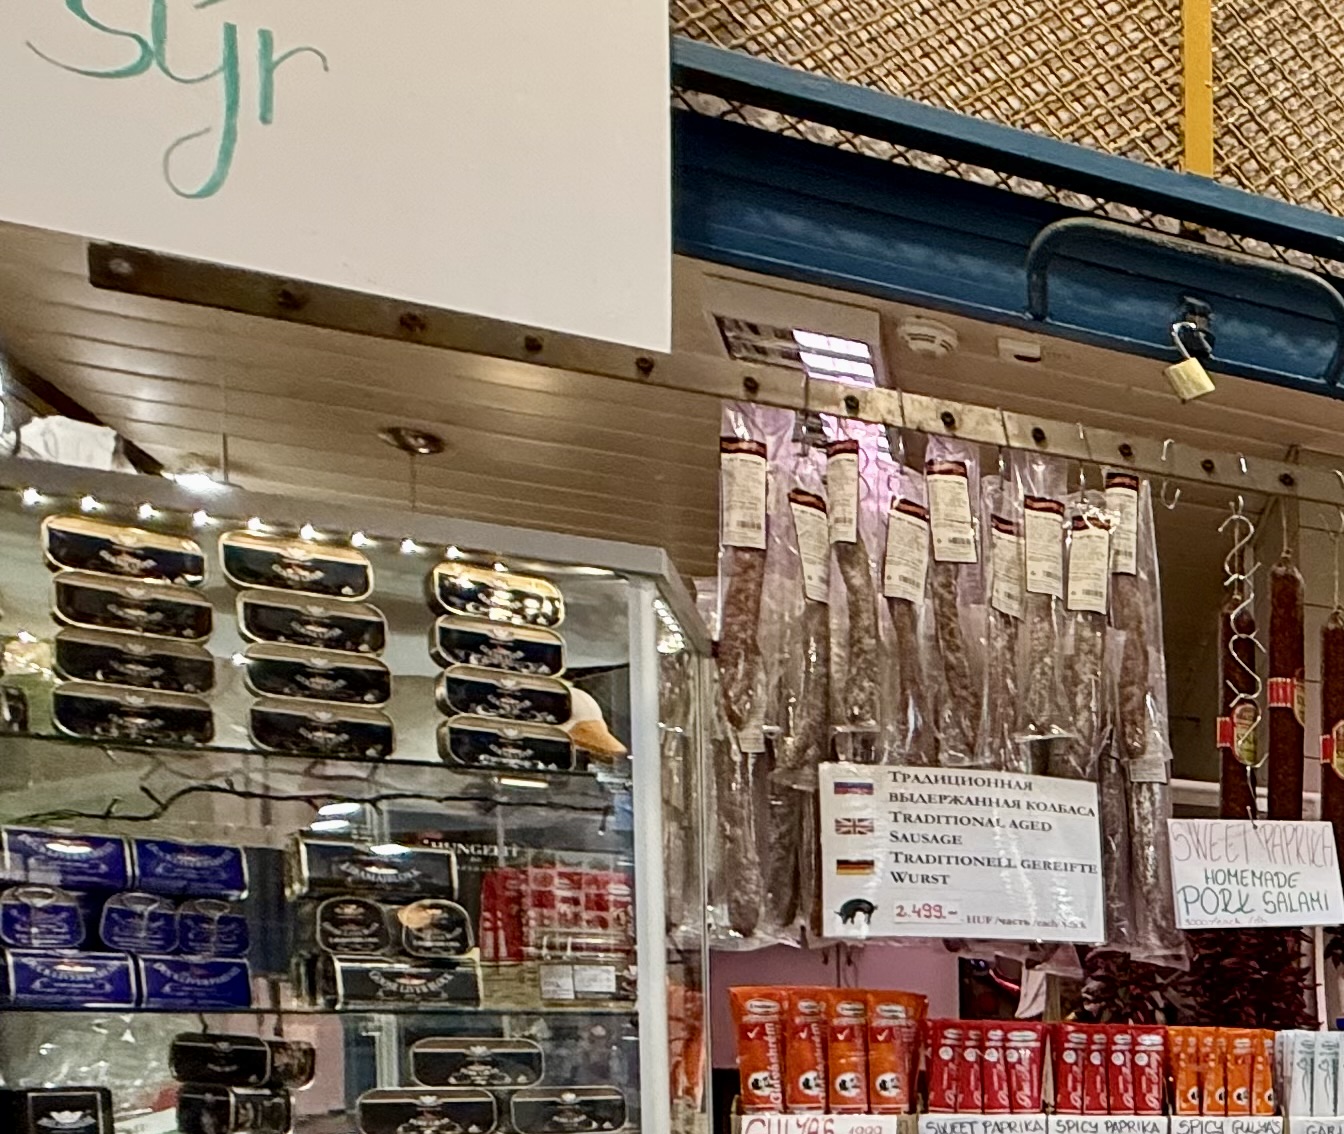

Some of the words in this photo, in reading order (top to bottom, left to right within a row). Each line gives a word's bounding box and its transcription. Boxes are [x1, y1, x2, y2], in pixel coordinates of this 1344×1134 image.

[1204, 869, 1301, 888] HOMEMADE
[1177, 885, 1255, 915] PORK
[1262, 890, 1330, 914] SALAMI
[982, 1119, 1045, 1134] PAPRIKA
[1055, 1119, 1098, 1134] SPICY
[1105, 1119, 1161, 1134] PAPRIKA
